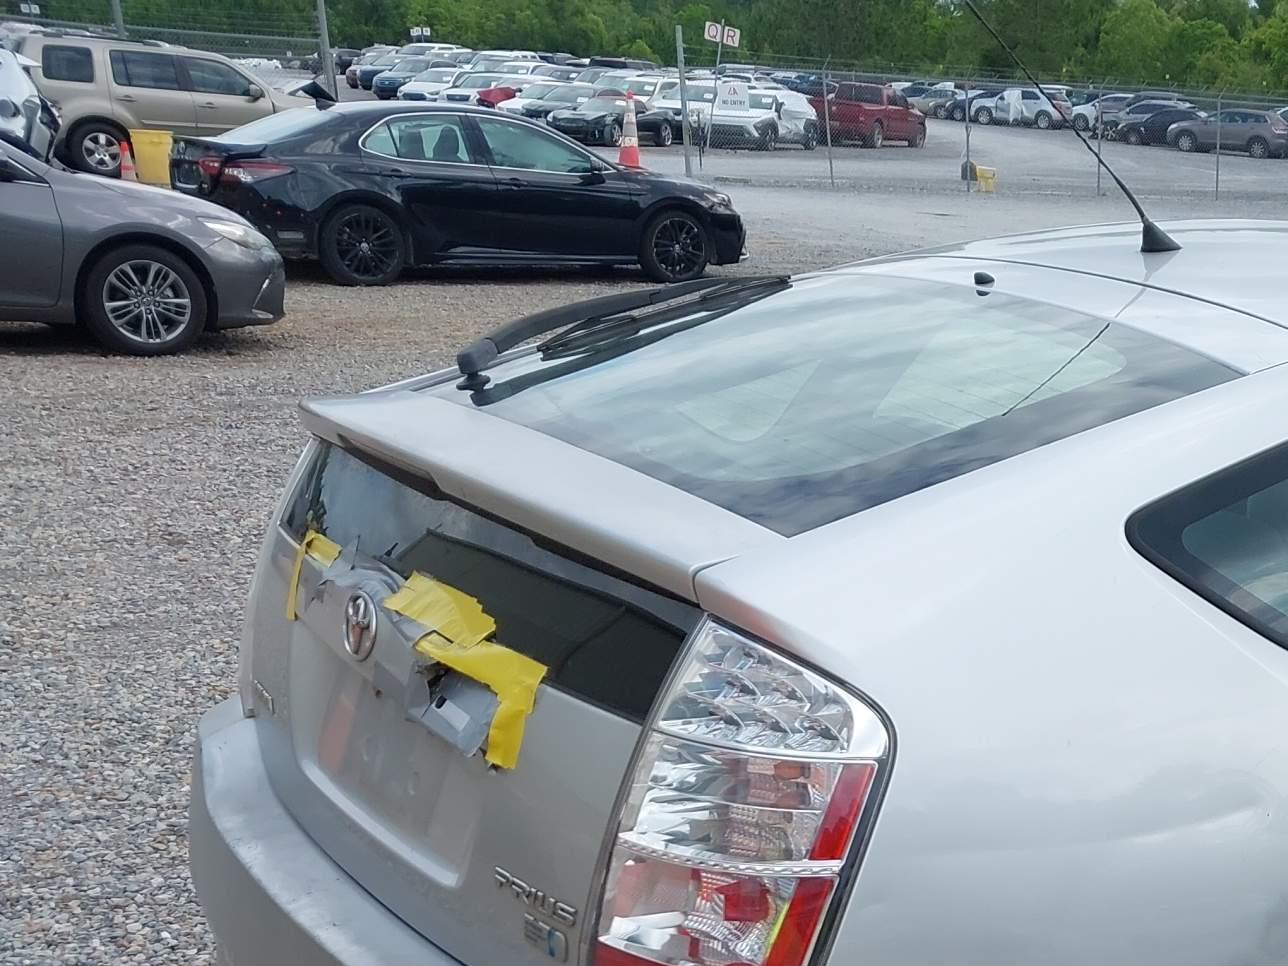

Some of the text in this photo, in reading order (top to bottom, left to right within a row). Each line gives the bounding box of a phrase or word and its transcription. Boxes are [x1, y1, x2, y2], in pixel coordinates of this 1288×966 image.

[708, 24, 718, 40] Q
[726, 29, 736, 44] R
[495, 865, 577, 928] PRIUS
